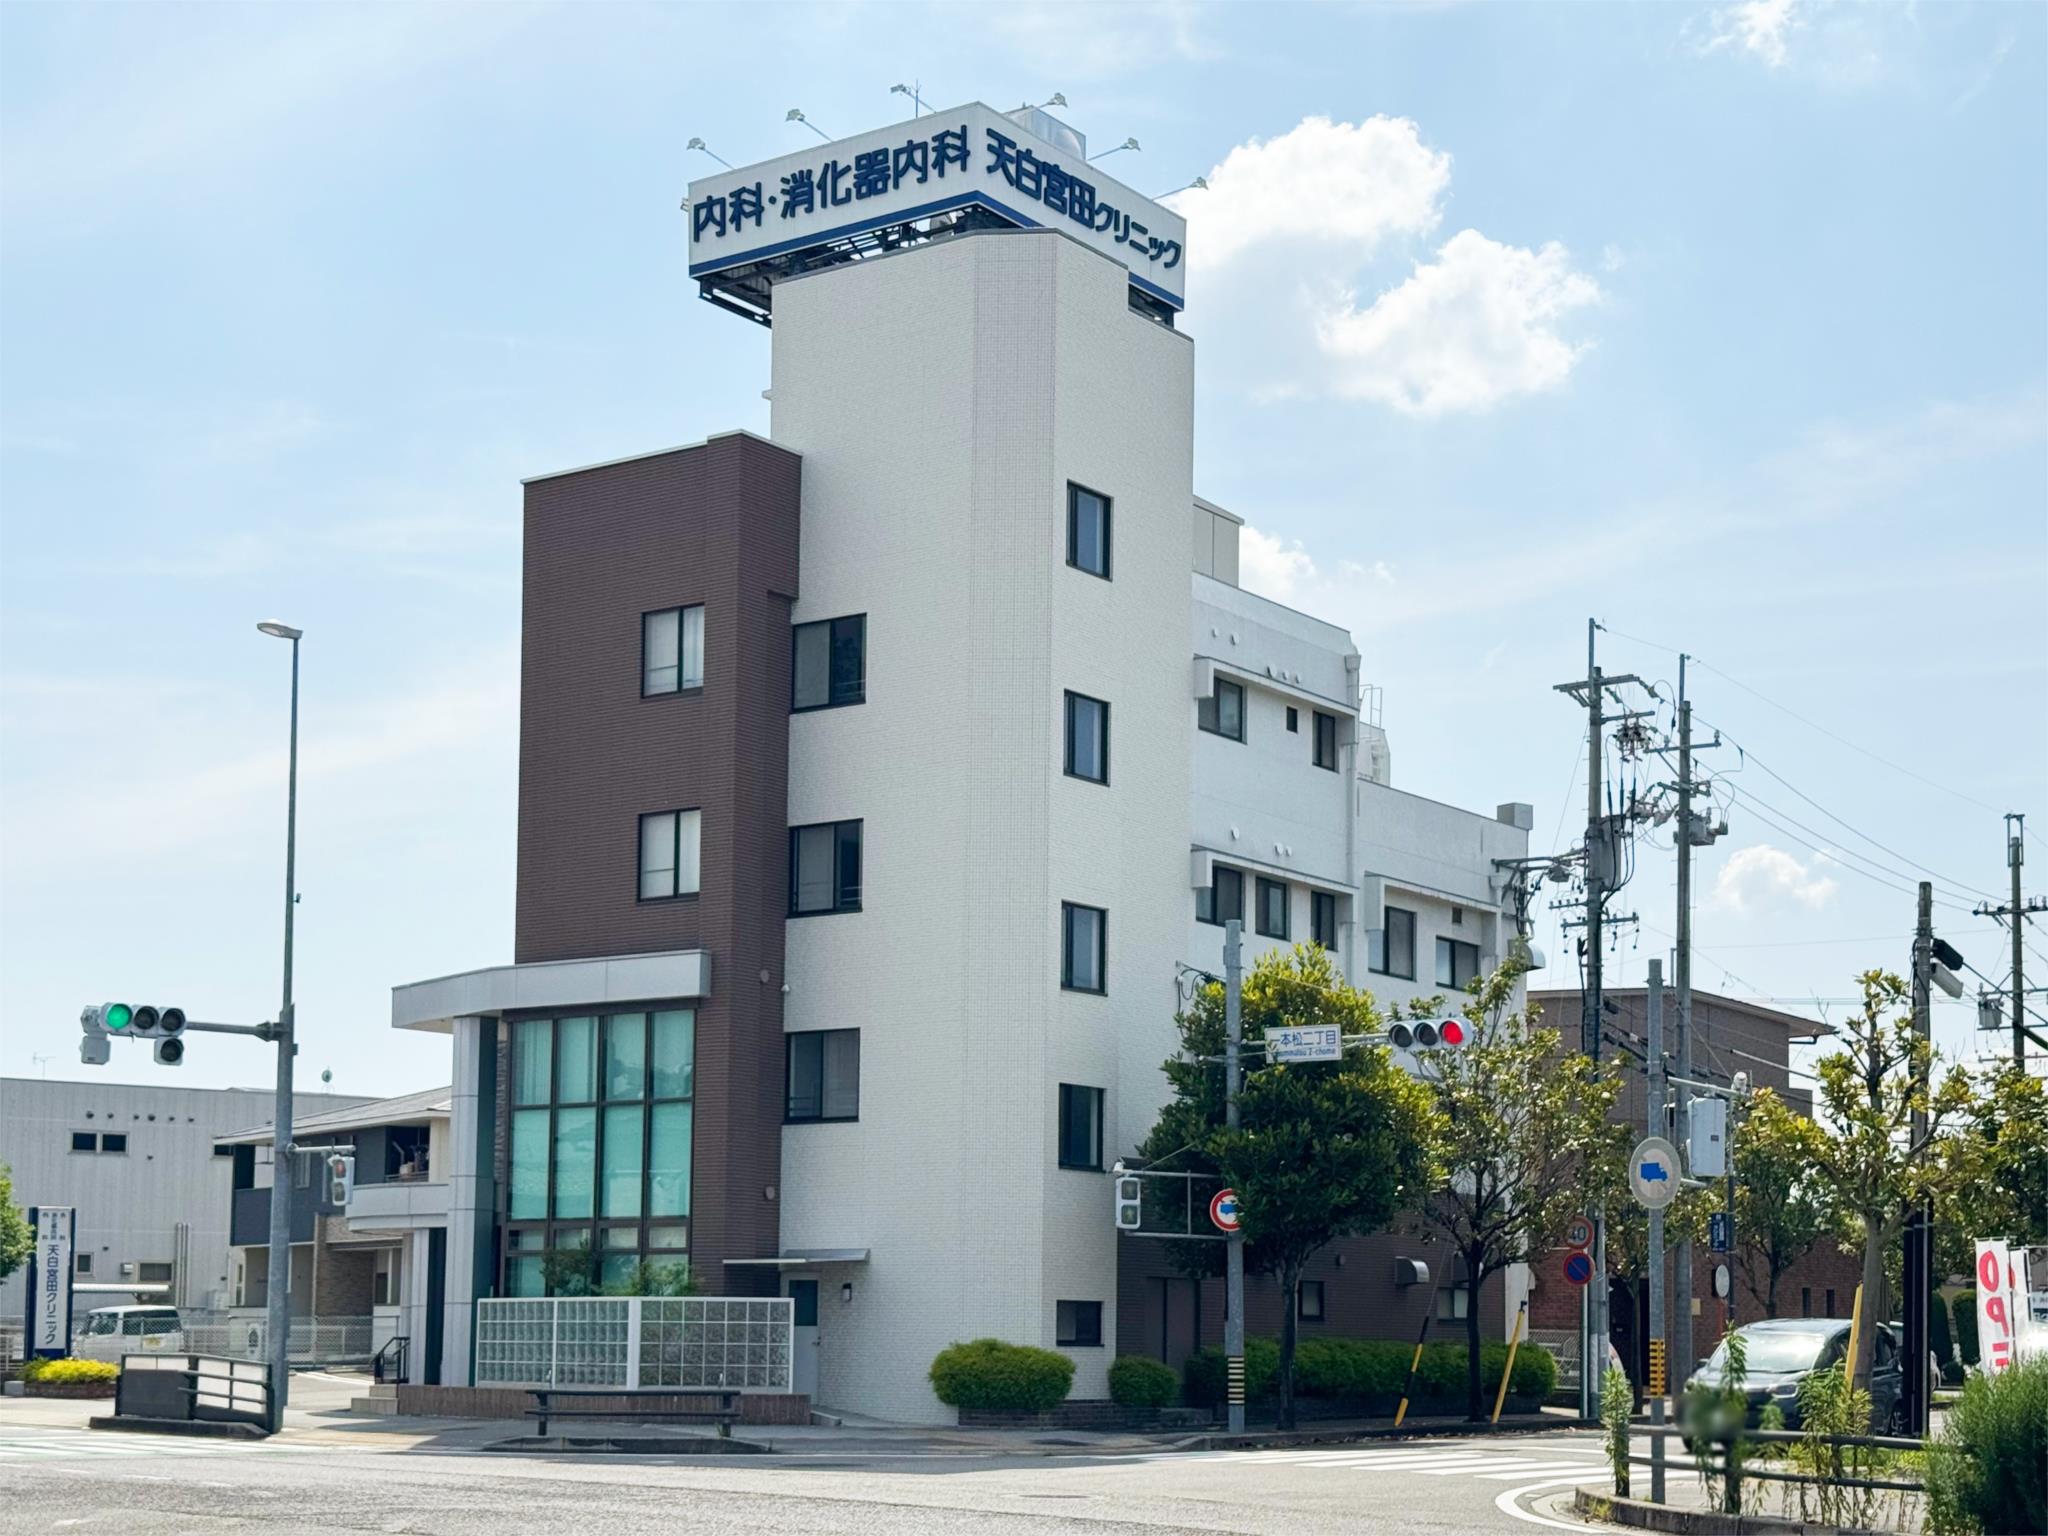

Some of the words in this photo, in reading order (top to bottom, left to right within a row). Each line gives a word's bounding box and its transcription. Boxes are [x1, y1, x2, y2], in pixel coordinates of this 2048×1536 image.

[693, 124, 970, 242] 内科・消化器内科
[986, 127, 1182, 269] 天白宮田クリニック
[1271, 1029, 1336, 1047] 一本松二丁目
[45, 1244, 60, 1345] 天白宮田クリニック
